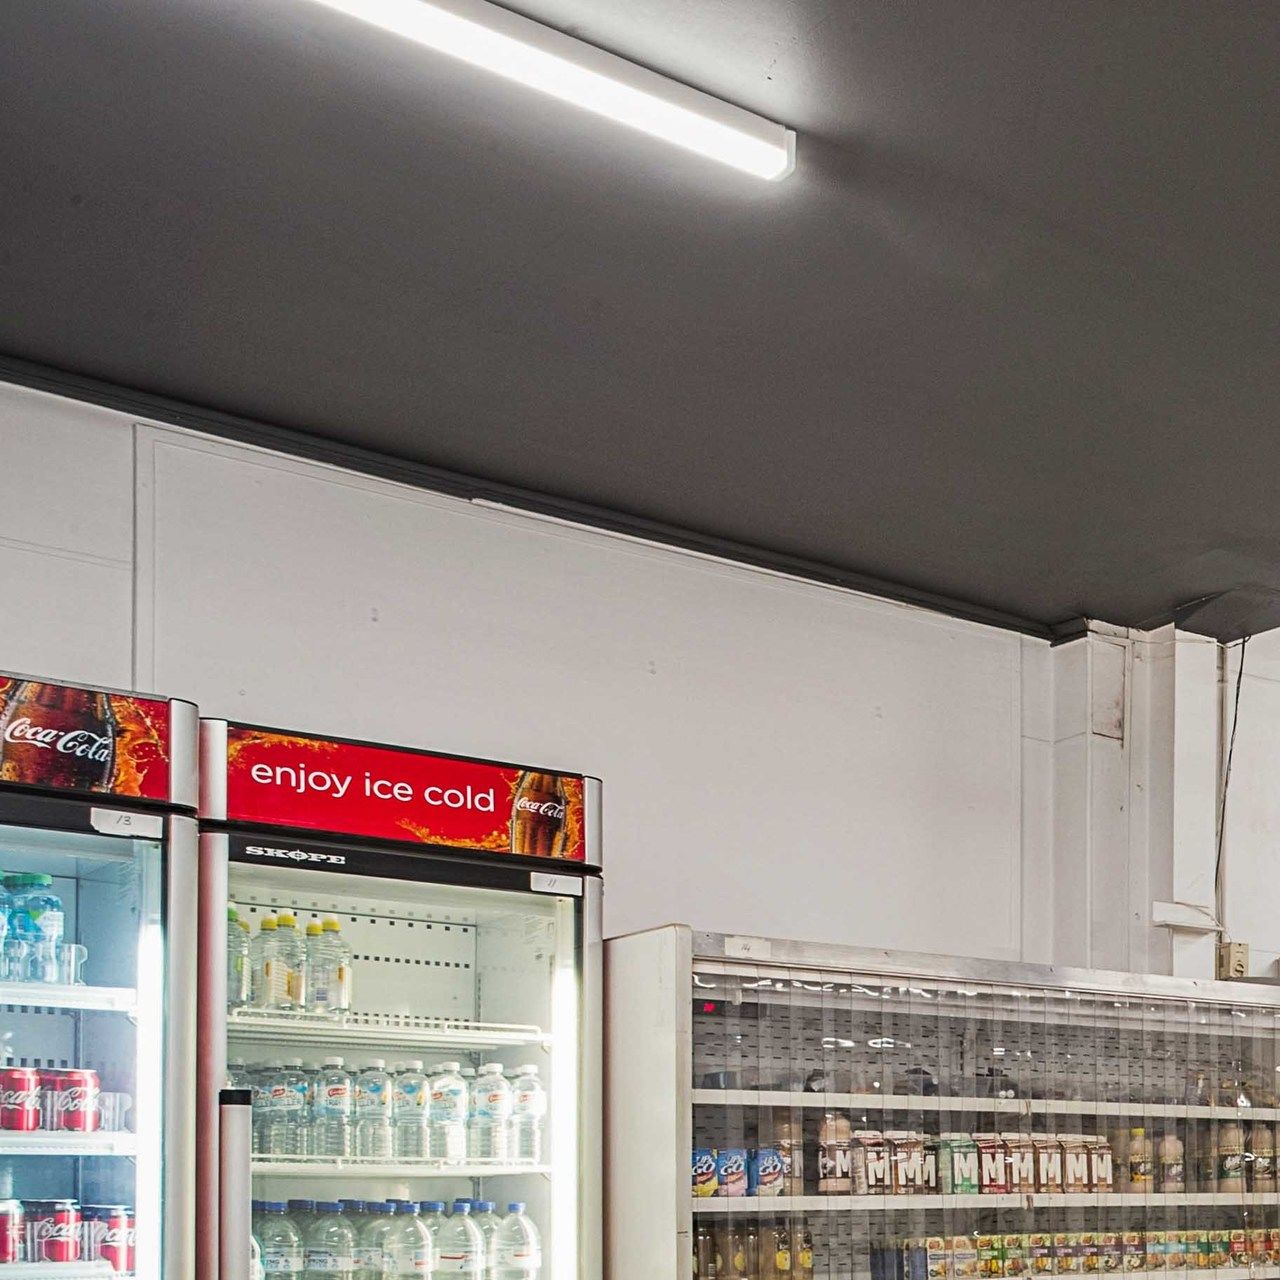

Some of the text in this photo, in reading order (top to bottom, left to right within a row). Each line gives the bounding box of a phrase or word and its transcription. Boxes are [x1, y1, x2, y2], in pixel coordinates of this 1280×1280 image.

[251, 762, 495, 812] enjoy ice cold
[246, 845, 346, 865] SKOPE
[981, 1153, 1006, 1185] M
[1039, 1153, 1062, 1185] M
[1065, 1153, 1088, 1185] M
